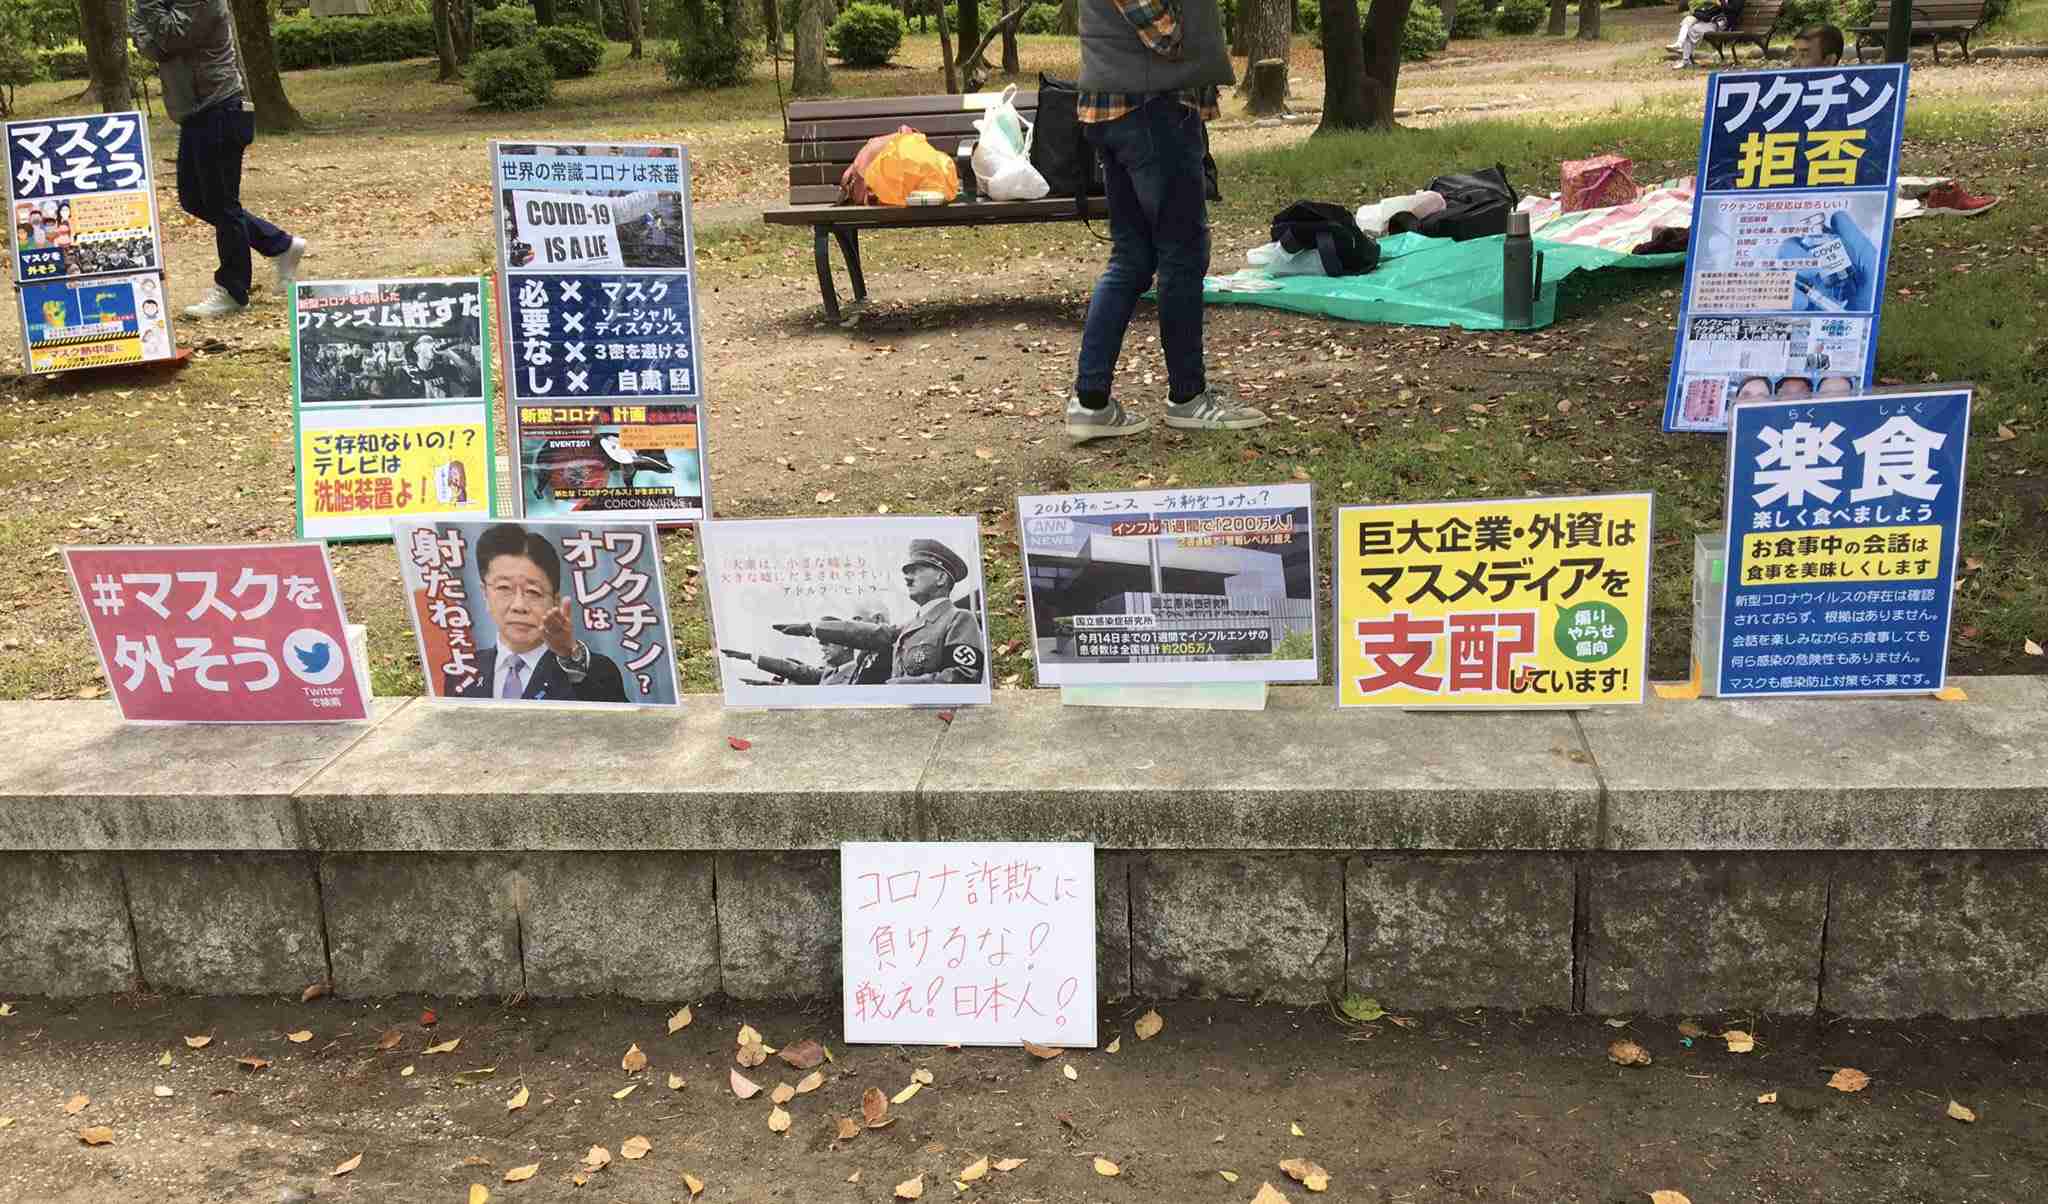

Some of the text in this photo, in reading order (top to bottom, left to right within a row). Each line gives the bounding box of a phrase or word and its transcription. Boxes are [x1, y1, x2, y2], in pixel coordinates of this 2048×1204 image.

[1717, 73, 1895, 133] ワクチン
[11, 117, 137, 158] マスク
[501, 161, 680, 183] 世界の常識コロナは茶番
[1735, 129, 1867, 188] 拒否
[17, 152, 144, 196] 外そう
[526, 200, 610, 226] COVID-19
[543, 235, 609, 263] IS A LIE
[600, 281, 669, 302] マスク
[602, 308, 676, 321] ソーシャル
[519, 279, 553, 394] 必要なし
[595, 321, 685, 336] ディスタンス
[594, 343, 689, 360] 3密を避ける
[618, 369, 662, 392] 自粛
[1788, 401, 1924, 420] らく しょく
[313, 455, 401, 476] テレビは
[1752, 415, 1948, 509] 楽食
[314, 476, 428, 513] 洗脳装置よ!
[1752, 504, 1933, 529] 楽しく食べましょう
[1359, 511, 1636, 557] 巨大企業・外資は
[1751, 532, 1929, 559] お食事中の会話は
[561, 530, 613, 631] オレは
[1360, 556, 1630, 604] マスメディアを
[1746, 559, 1932, 582] 食事を美味しくします
[91, 567, 322, 622] #マスクを
[1735, 588, 1936, 608] 新型コロナウイルスの存在は確認
[602, 530, 664, 695] ワクチン?
[1734, 608, 1939, 626] されておらず、根拠はありません。
[1567, 624, 1617, 641] やらせ
[1732, 630, 1931, 649] 会話を楽しみながらお食事しても
[113, 635, 281, 693] 外そう
[1358, 612, 1629, 694] 支配 しています!
[1731, 652, 1921, 669] 何ら感染の危険性もありません。
[1730, 672, 1932, 690] マスクも感染防止対策も不要です。
[857, 859, 1080, 912] コロナ詐欺に
[868, 921, 1052, 971] 負けるな!
